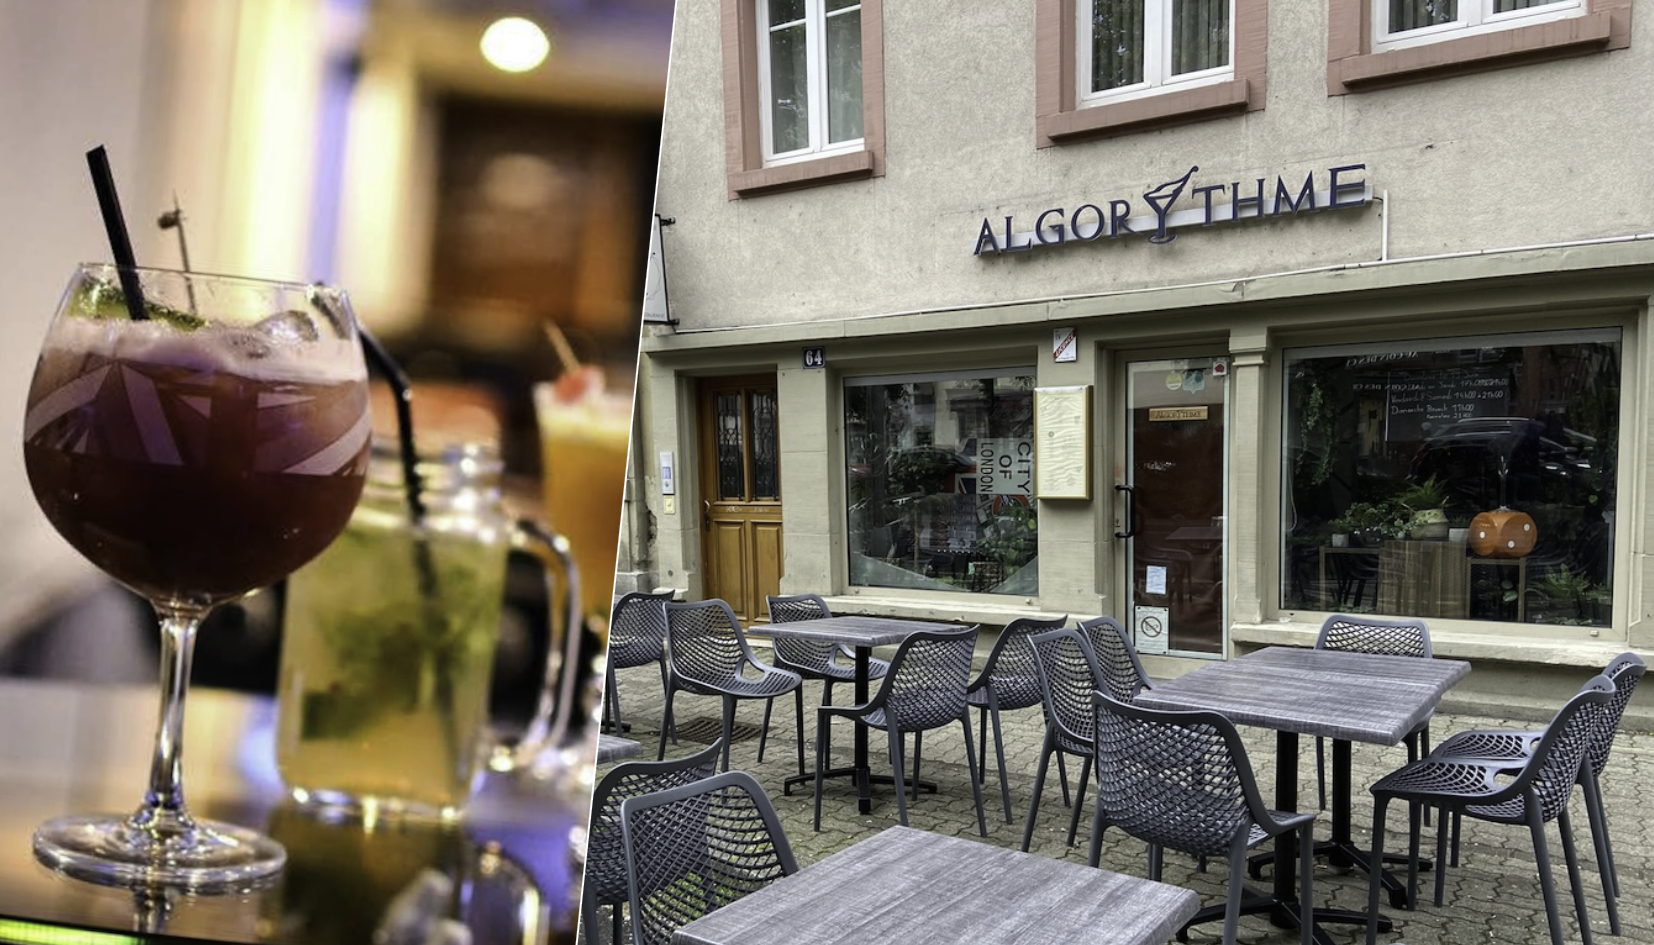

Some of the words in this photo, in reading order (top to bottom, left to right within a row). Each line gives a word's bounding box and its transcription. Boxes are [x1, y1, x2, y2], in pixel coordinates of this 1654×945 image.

[973, 164, 1366, 256] ALGORYTHME
[805, 350, 823, 366] 64
[980, 442, 994, 493] LONDON
[999, 454, 1012, 480] OF
[1017, 441, 1031, 494] CITY
